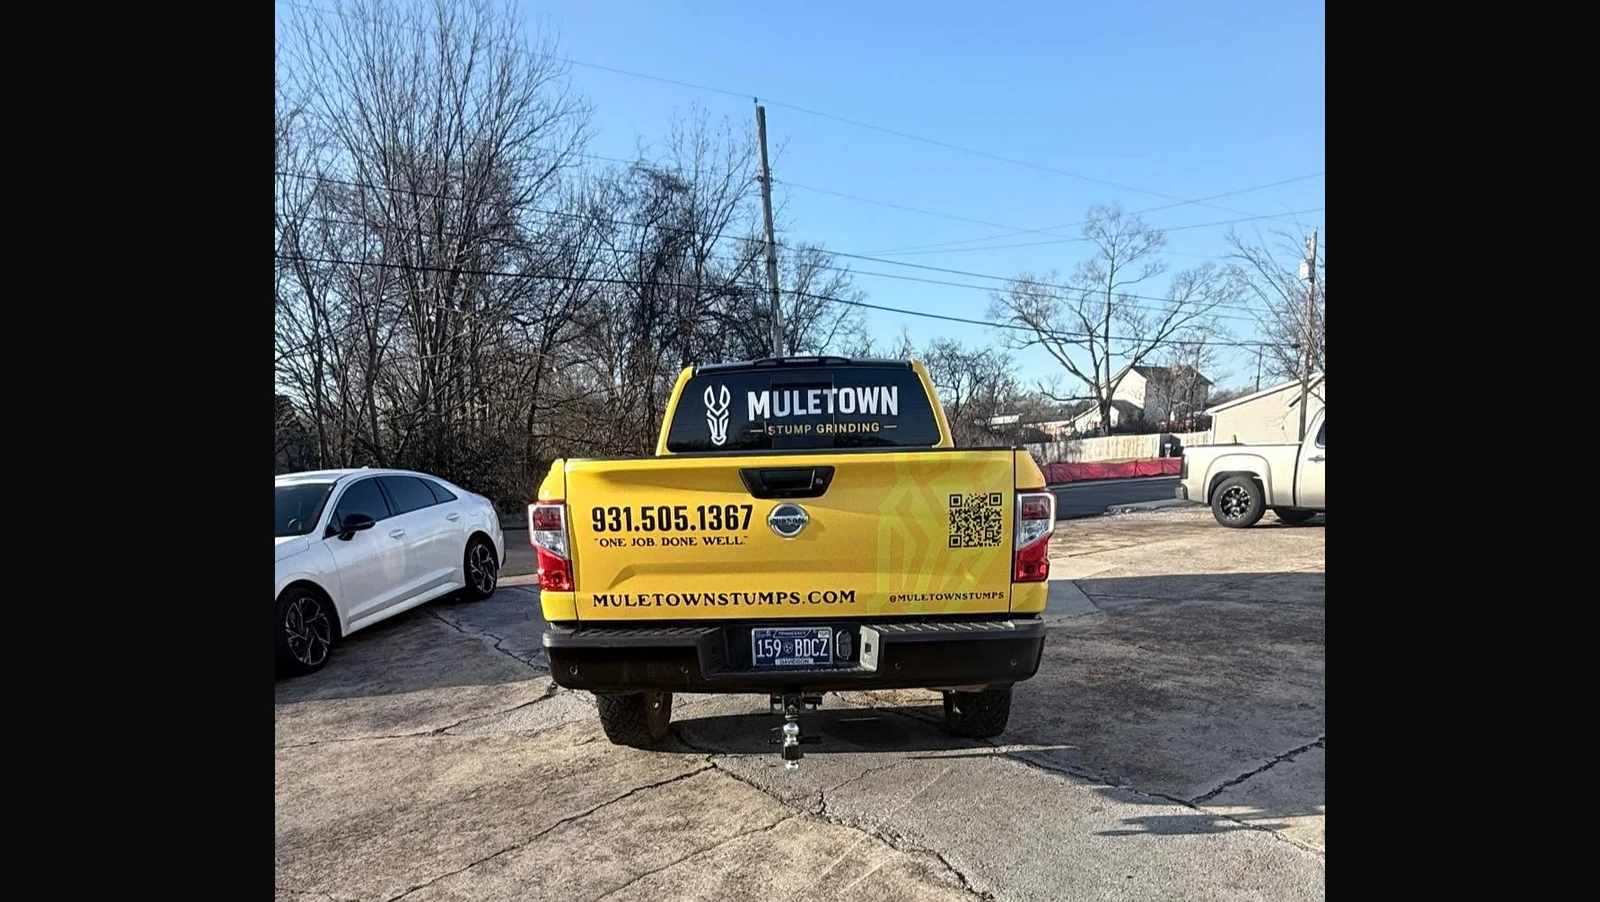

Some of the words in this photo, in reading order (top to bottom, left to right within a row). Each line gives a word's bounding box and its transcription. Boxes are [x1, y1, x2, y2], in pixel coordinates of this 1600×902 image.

[747, 385, 899, 421] MULETOWN
[768, 424, 812, 436] STUMP
[816, 422, 880, 434] GRINDING
[591, 504, 754, 532] 931.505.1367
[770, 517, 807, 525] NISSAN
[661, 537, 698, 547] DONE
[593, 590, 856, 607] MULETOWNSTUMPS.COM
[889, 592, 1005, 603] @MULETOWNSTUMPS
[757, 639, 782, 658] 159
[795, 638, 829, 657] BDCZ
